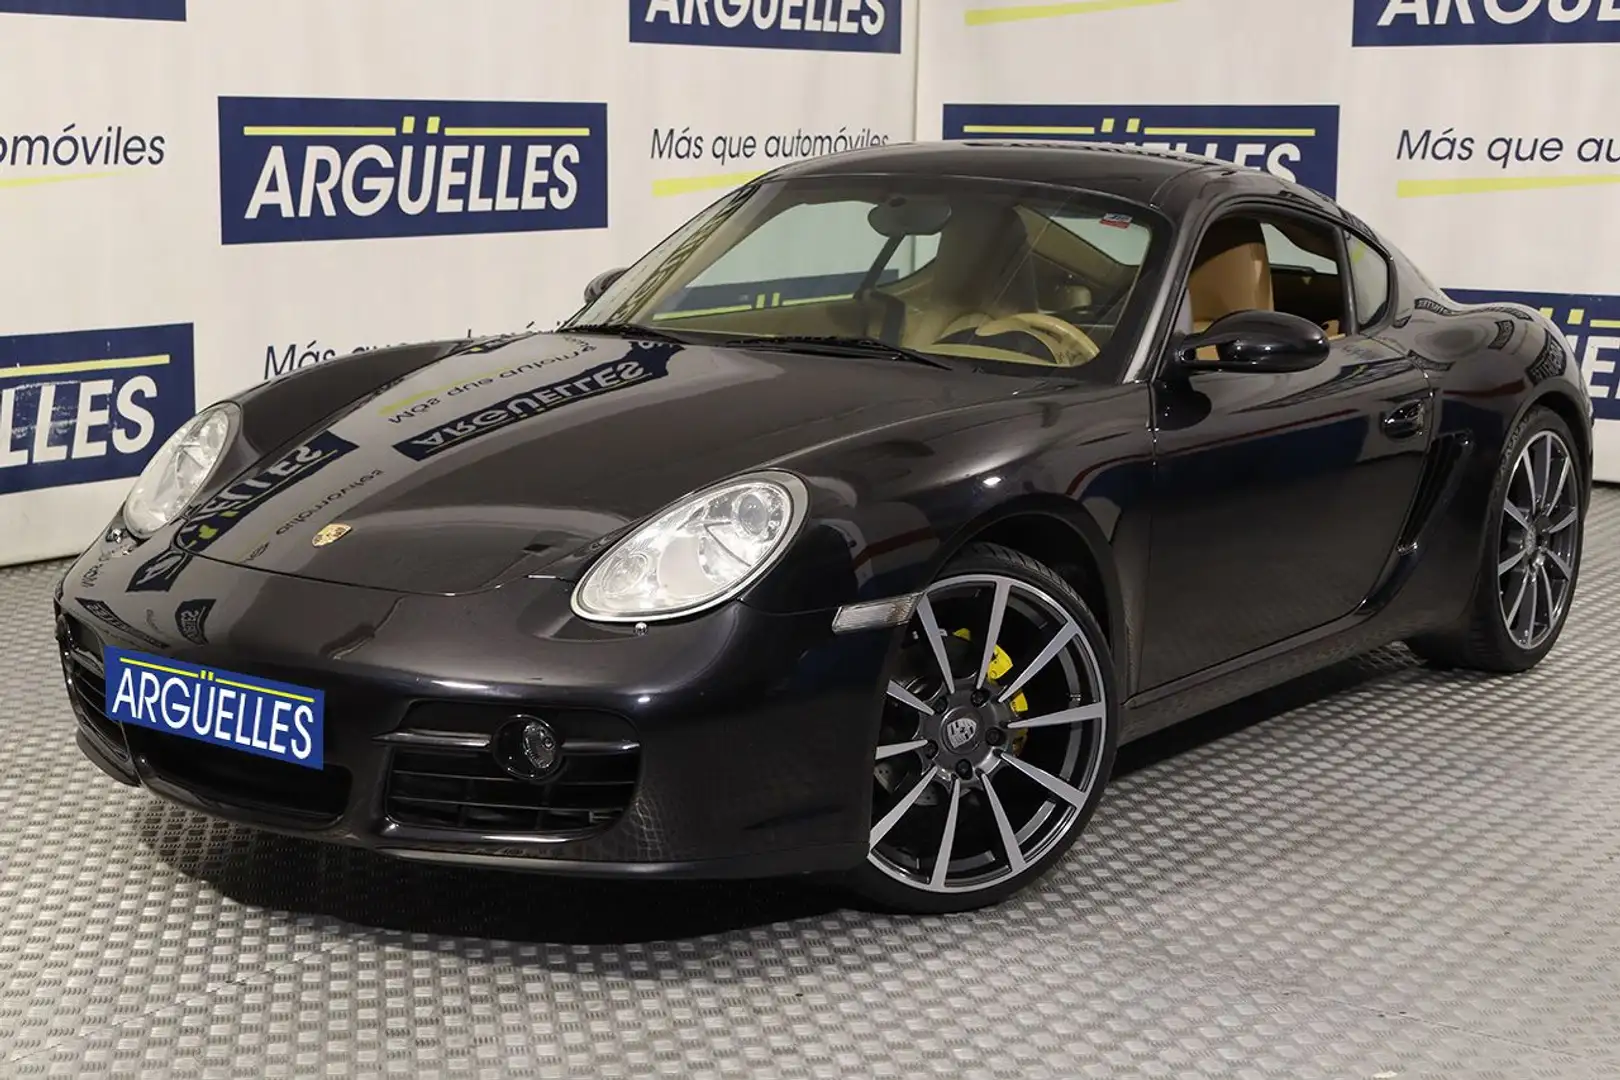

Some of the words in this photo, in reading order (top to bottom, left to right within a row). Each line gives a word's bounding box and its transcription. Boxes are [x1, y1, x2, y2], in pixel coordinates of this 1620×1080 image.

[0, 123, 165, 166] móviles
[650, 126, 704, 160] Más
[711, 134, 757, 166] que
[1396, 127, 1475, 161] Más
[1487, 137, 1564, 169] que
[244, 116, 580, 219] ARGÜELLES
